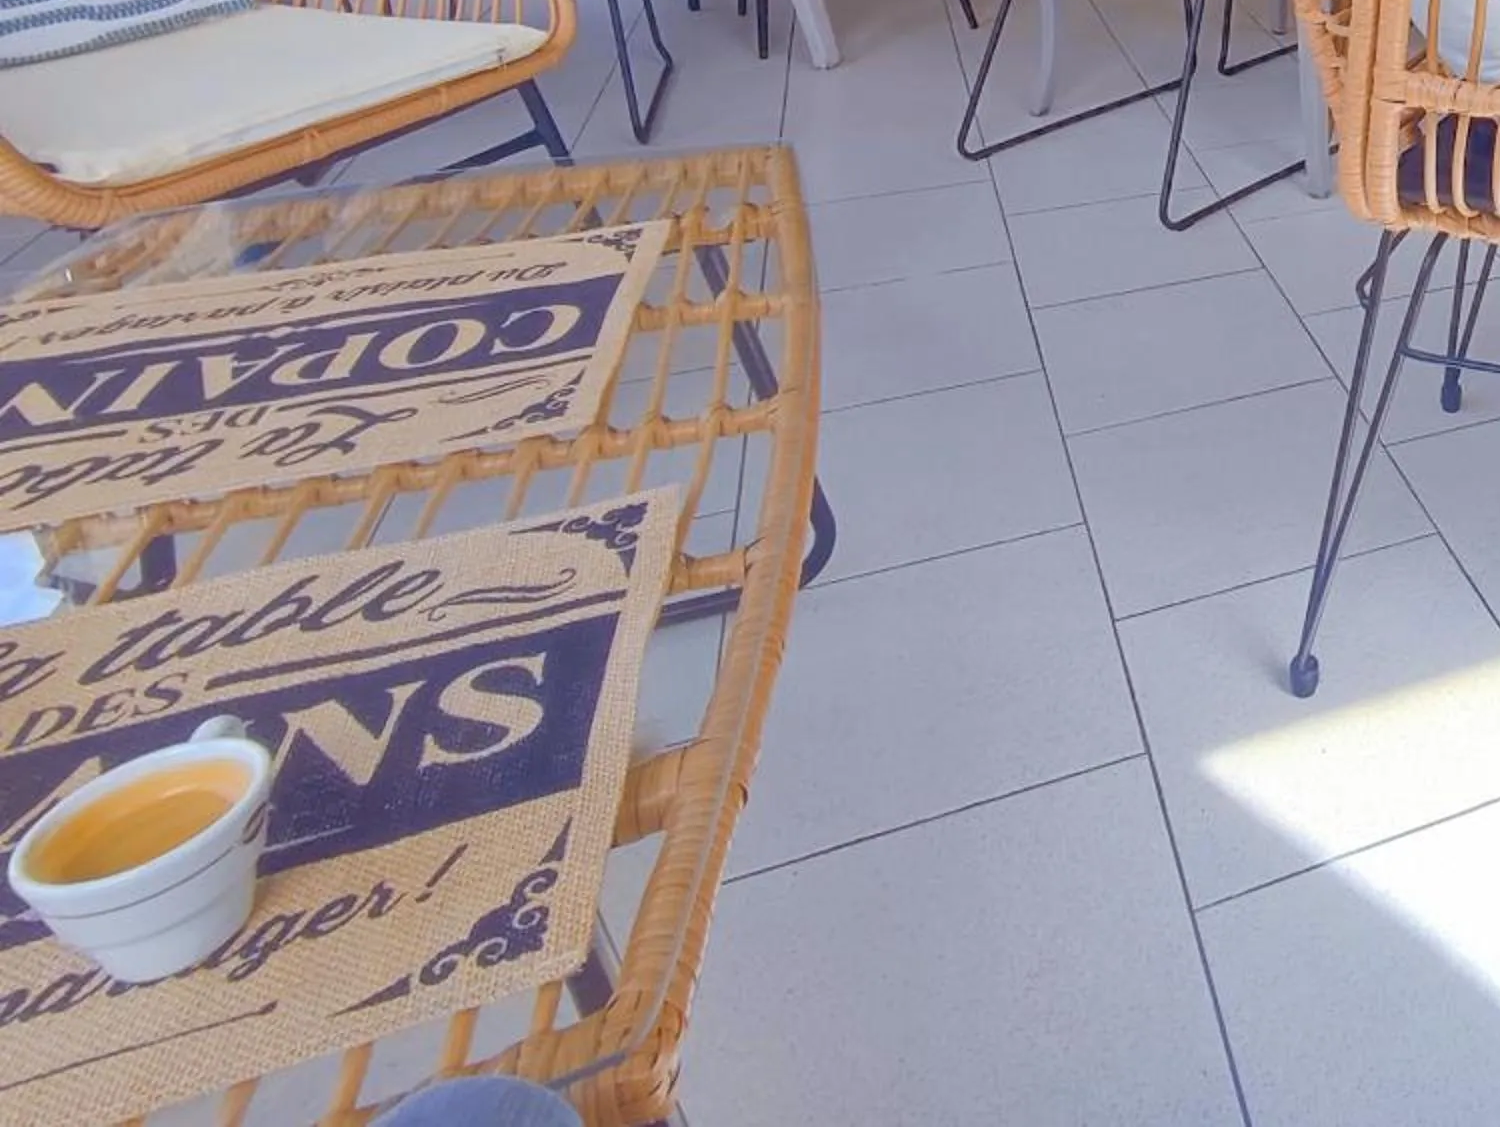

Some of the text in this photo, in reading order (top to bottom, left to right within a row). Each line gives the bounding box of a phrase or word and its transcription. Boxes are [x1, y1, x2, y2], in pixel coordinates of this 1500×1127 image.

[137, 405, 272, 445] DES
[240, 404, 419, 468] La
[77, 559, 444, 686] table
[4, 672, 189, 750] DES
